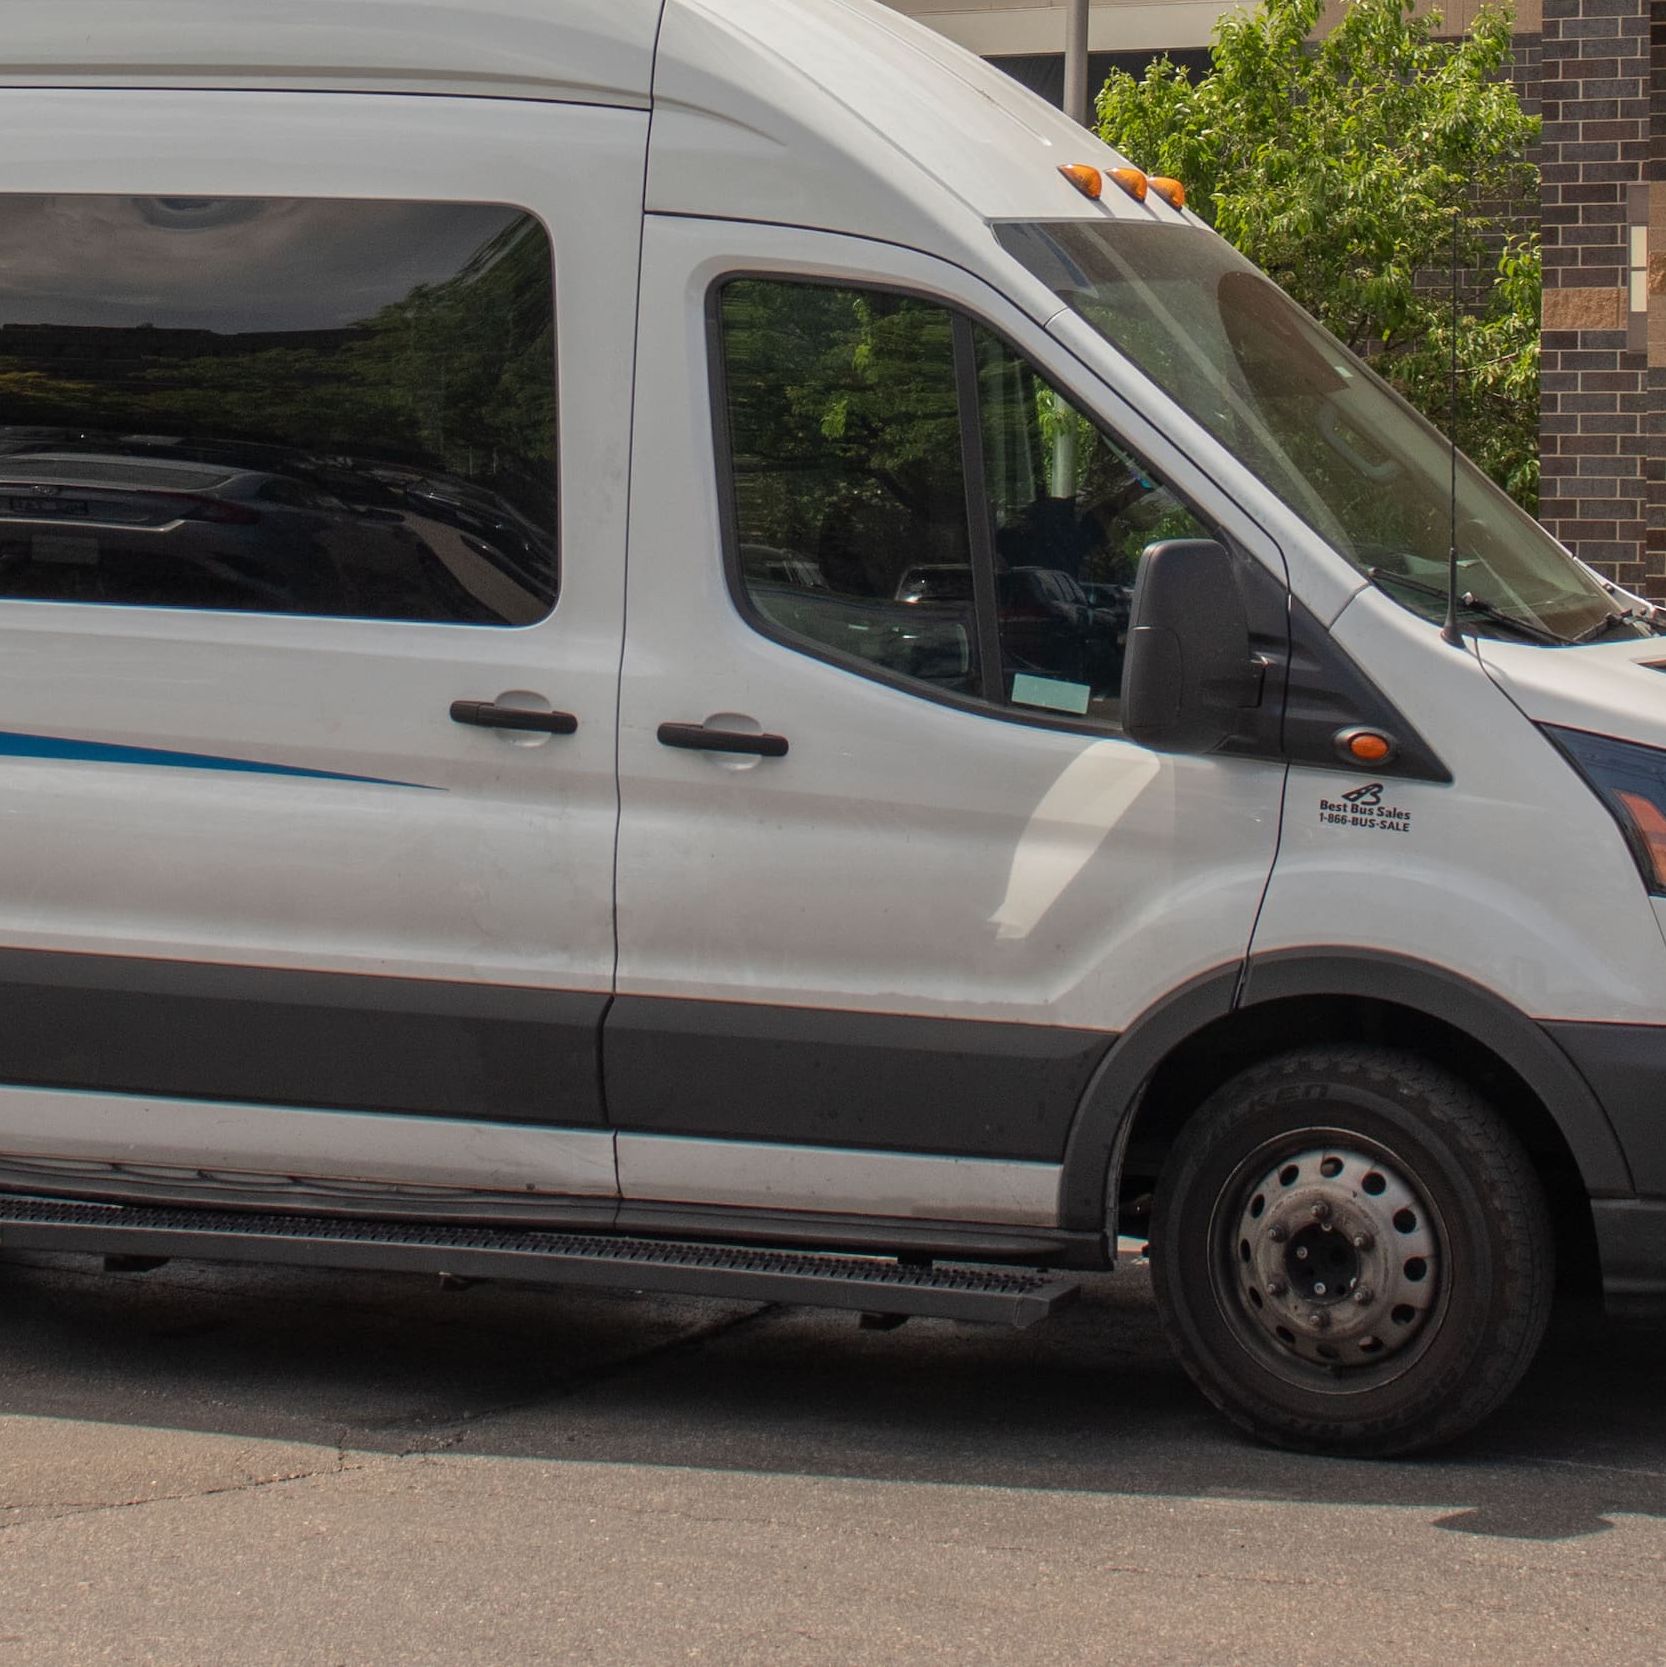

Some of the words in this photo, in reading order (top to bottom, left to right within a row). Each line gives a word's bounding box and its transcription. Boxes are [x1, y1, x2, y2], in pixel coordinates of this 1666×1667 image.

[1320, 800, 1347, 813] Best
[1351, 804, 1373, 816] Bus
[1377, 806, 1411, 820] Sales
[1319, 812, 1410, 832] 1-866-BUS-SALE
